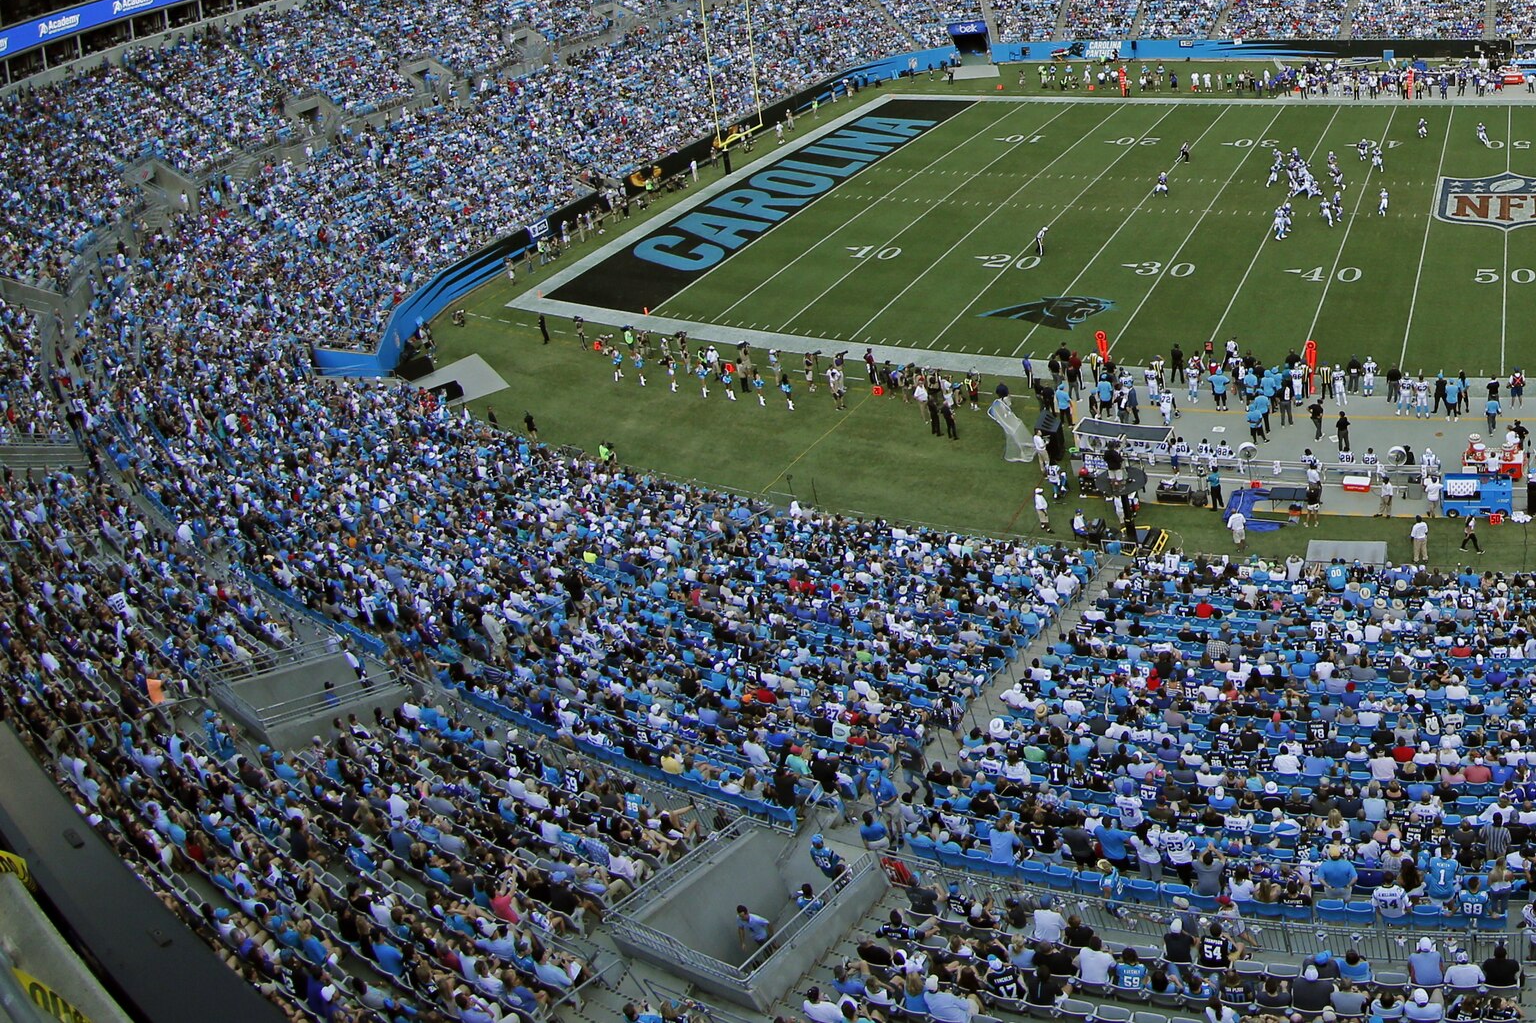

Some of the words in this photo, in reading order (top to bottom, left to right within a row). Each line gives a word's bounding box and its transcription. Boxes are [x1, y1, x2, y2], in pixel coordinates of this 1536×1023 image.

[48, 14, 80, 31] Academy
[959, 23, 978, 34] belk
[1089, 41, 1122, 50] CAROLINA
[632, 115, 938, 272] CAROLINA
[852, 245, 902, 261] 10
[983, 254, 1042, 271] 20
[1136, 262, 1196, 278] 30
[1301, 267, 1363, 283] 40
[1474, 268, 1536, 284] 50
[1162, 396, 1172, 404] 72
[1490, 514, 1500, 524] 50
[1166, 842, 1184, 852] 23
[1438, 869, 1445, 886] 1
[1379, 898, 1397, 909] 34
[1463, 902, 1483, 915] 88
[1204, 945, 1222, 960] 54
[1124, 977, 1139, 988] 59
